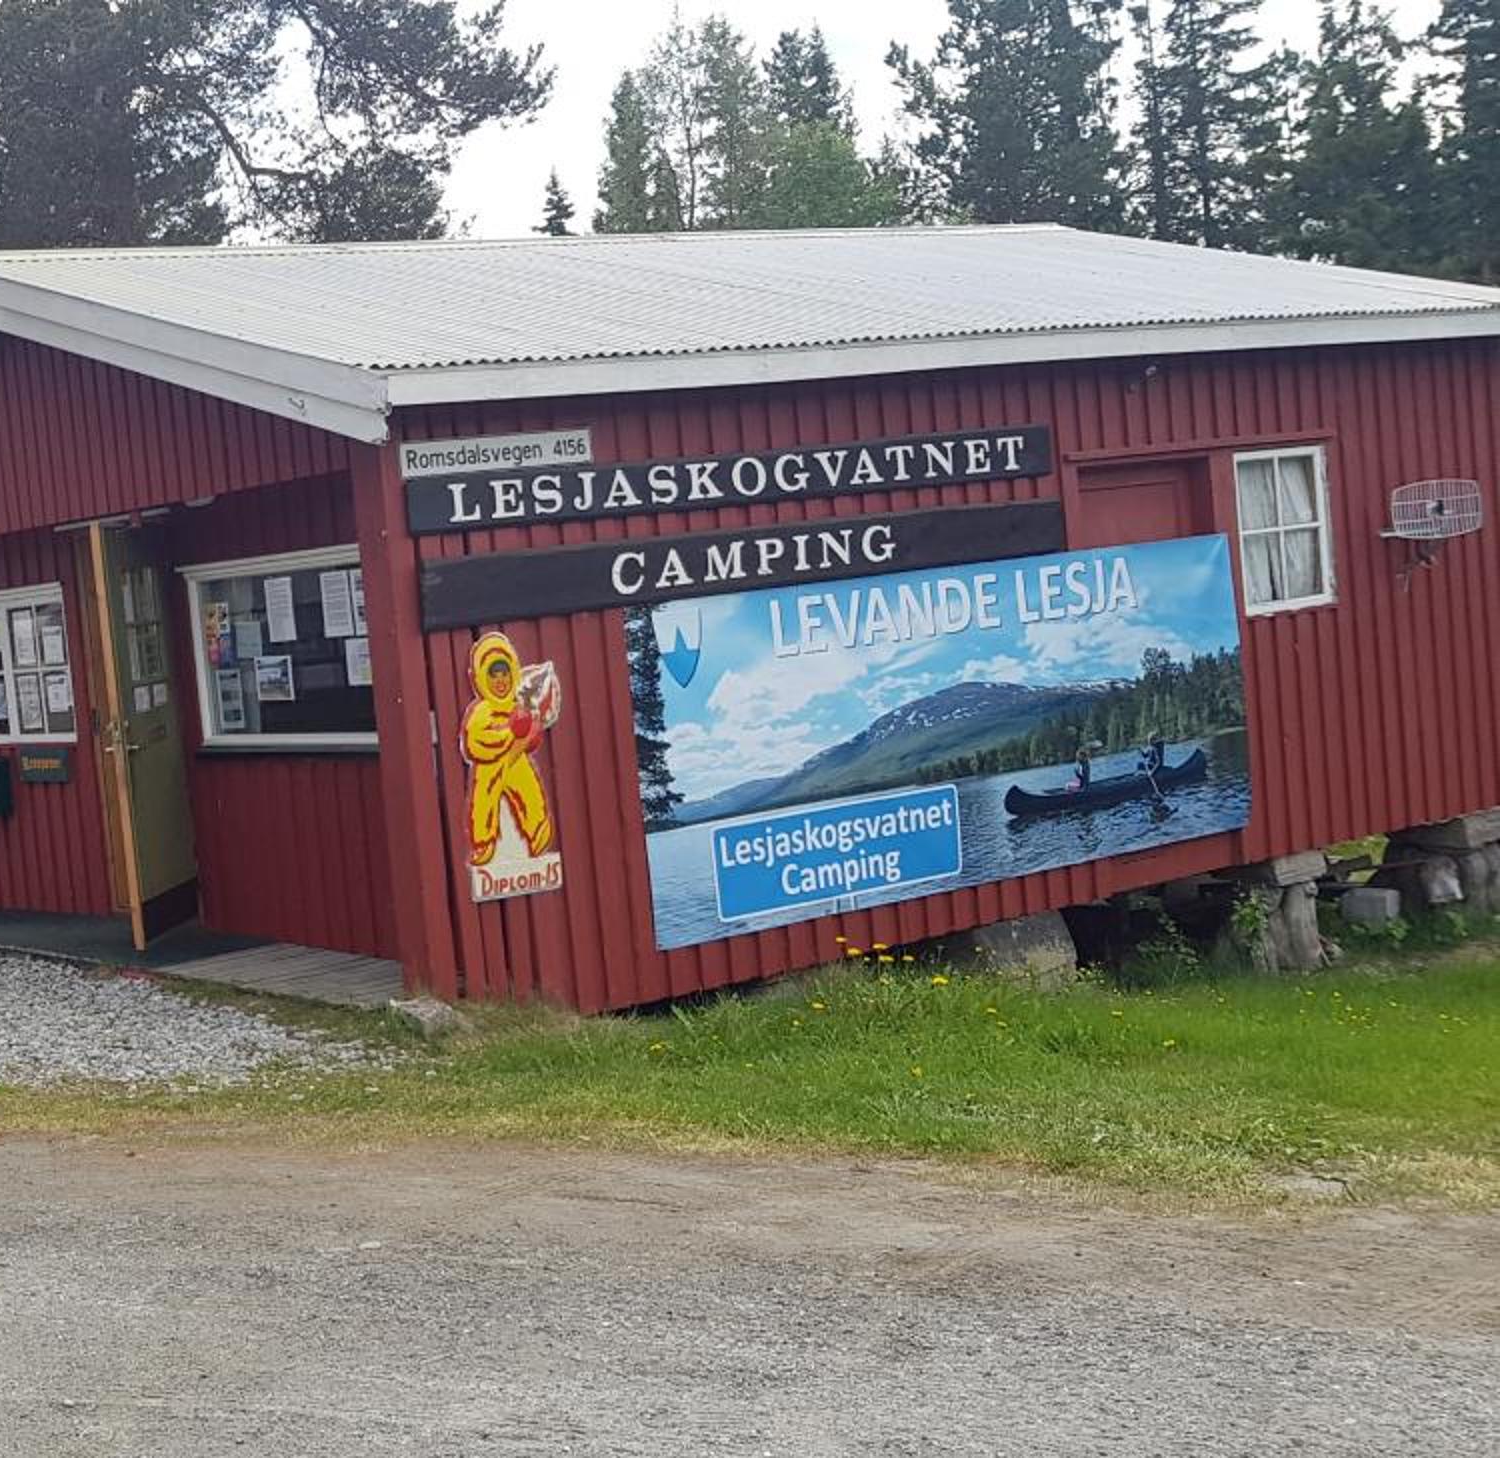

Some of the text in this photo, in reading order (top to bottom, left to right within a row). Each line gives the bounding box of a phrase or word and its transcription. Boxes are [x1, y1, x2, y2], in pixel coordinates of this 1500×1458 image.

[406, 438, 586, 469] Romsdalsvegen 4156
[447, 436, 1024, 523] LESJASKOGVATNET
[611, 525, 896, 595] CAMPING
[769, 557, 1138, 658] LEVANDE LESJA
[719, 799, 953, 868] Lesjaskogsvatnet
[781, 850, 900, 895] Camping
